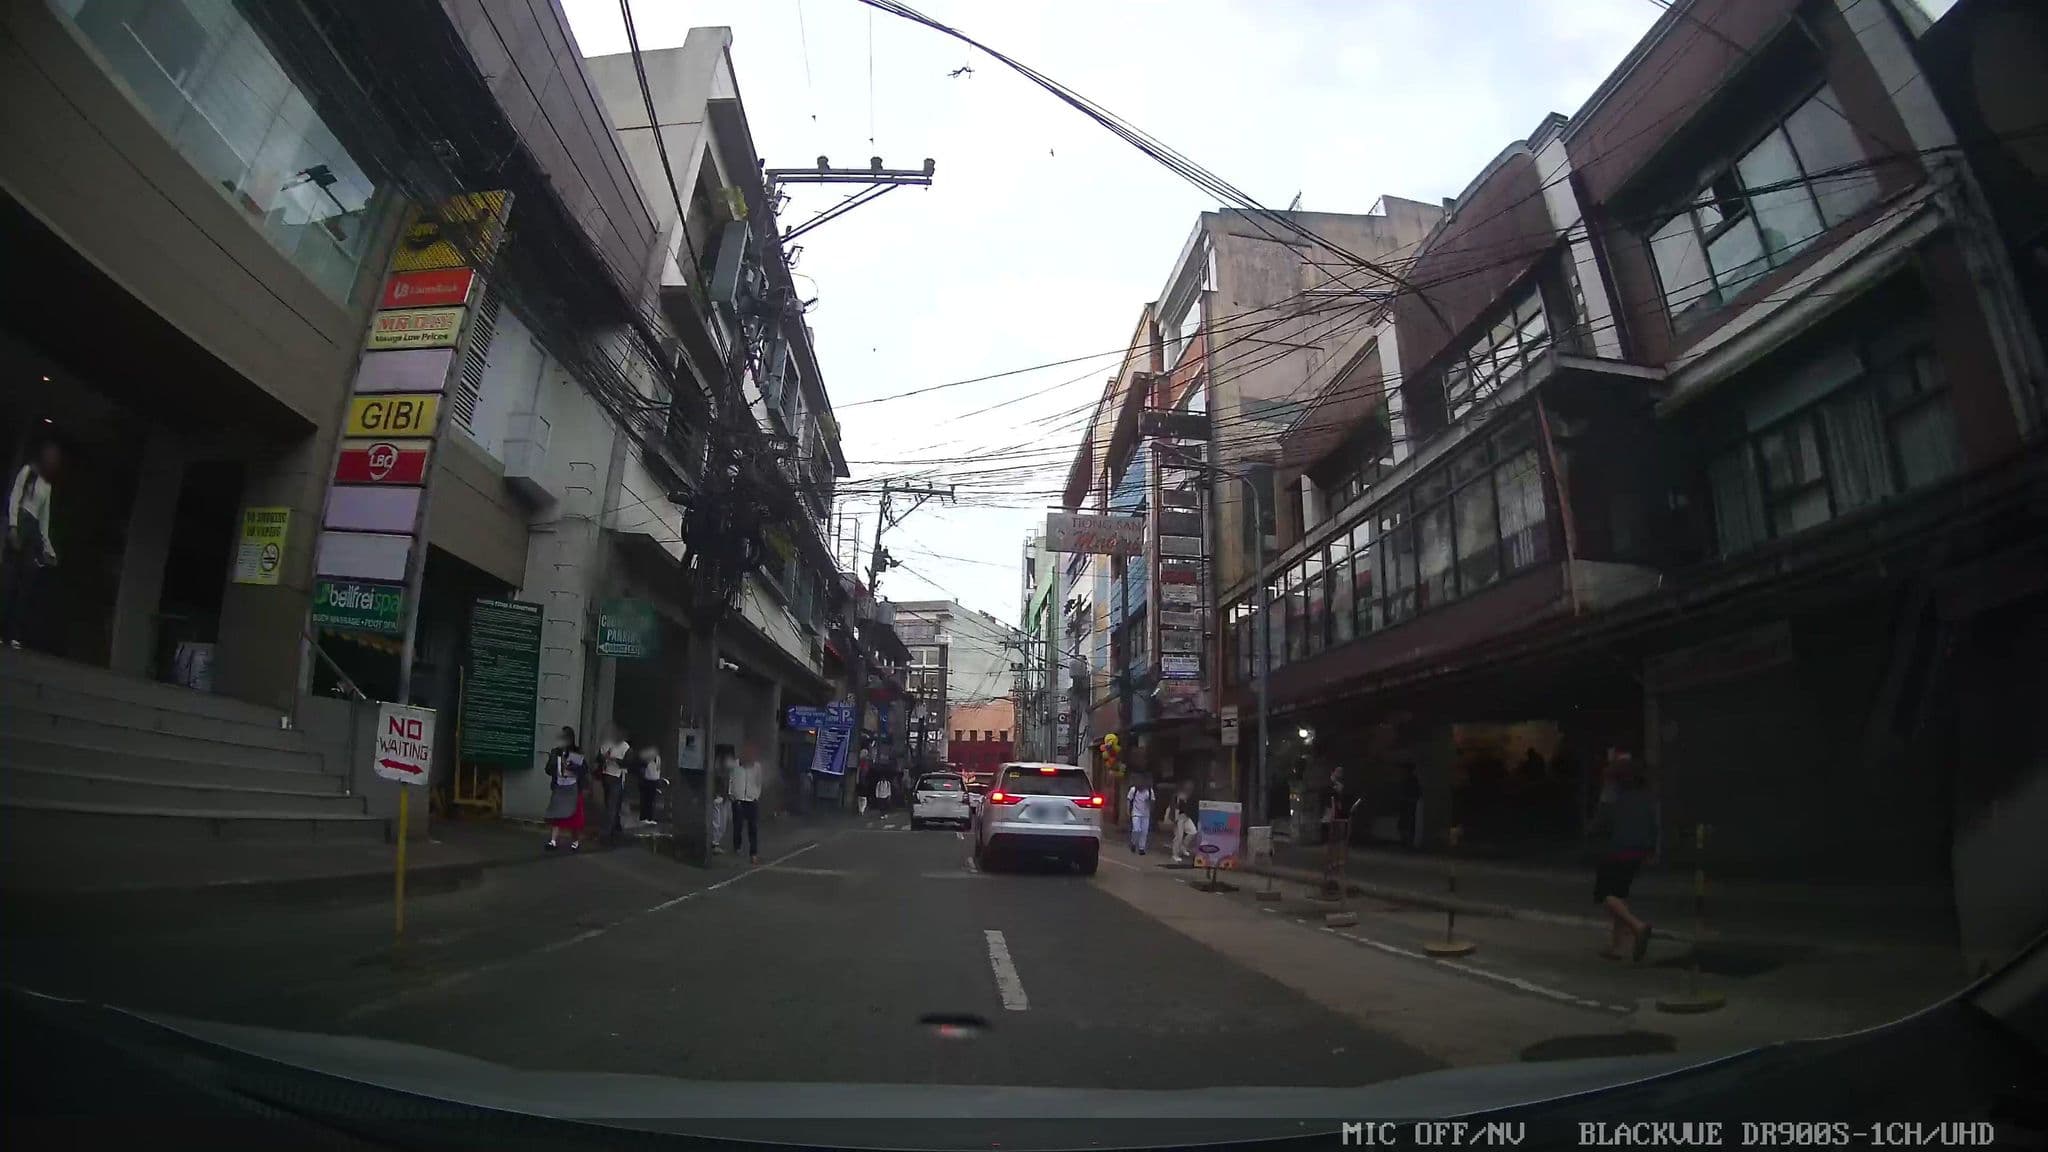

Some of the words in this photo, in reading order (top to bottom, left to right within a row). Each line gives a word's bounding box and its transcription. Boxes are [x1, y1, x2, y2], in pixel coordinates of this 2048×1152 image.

[403, 333, 420, 342] Low
[421, 332, 449, 341] Prices
[361, 400, 425, 430] GIBI
[368, 454, 395, 470] LBC
[389, 715, 422, 741] NO
[379, 736, 429, 761] WAITING
